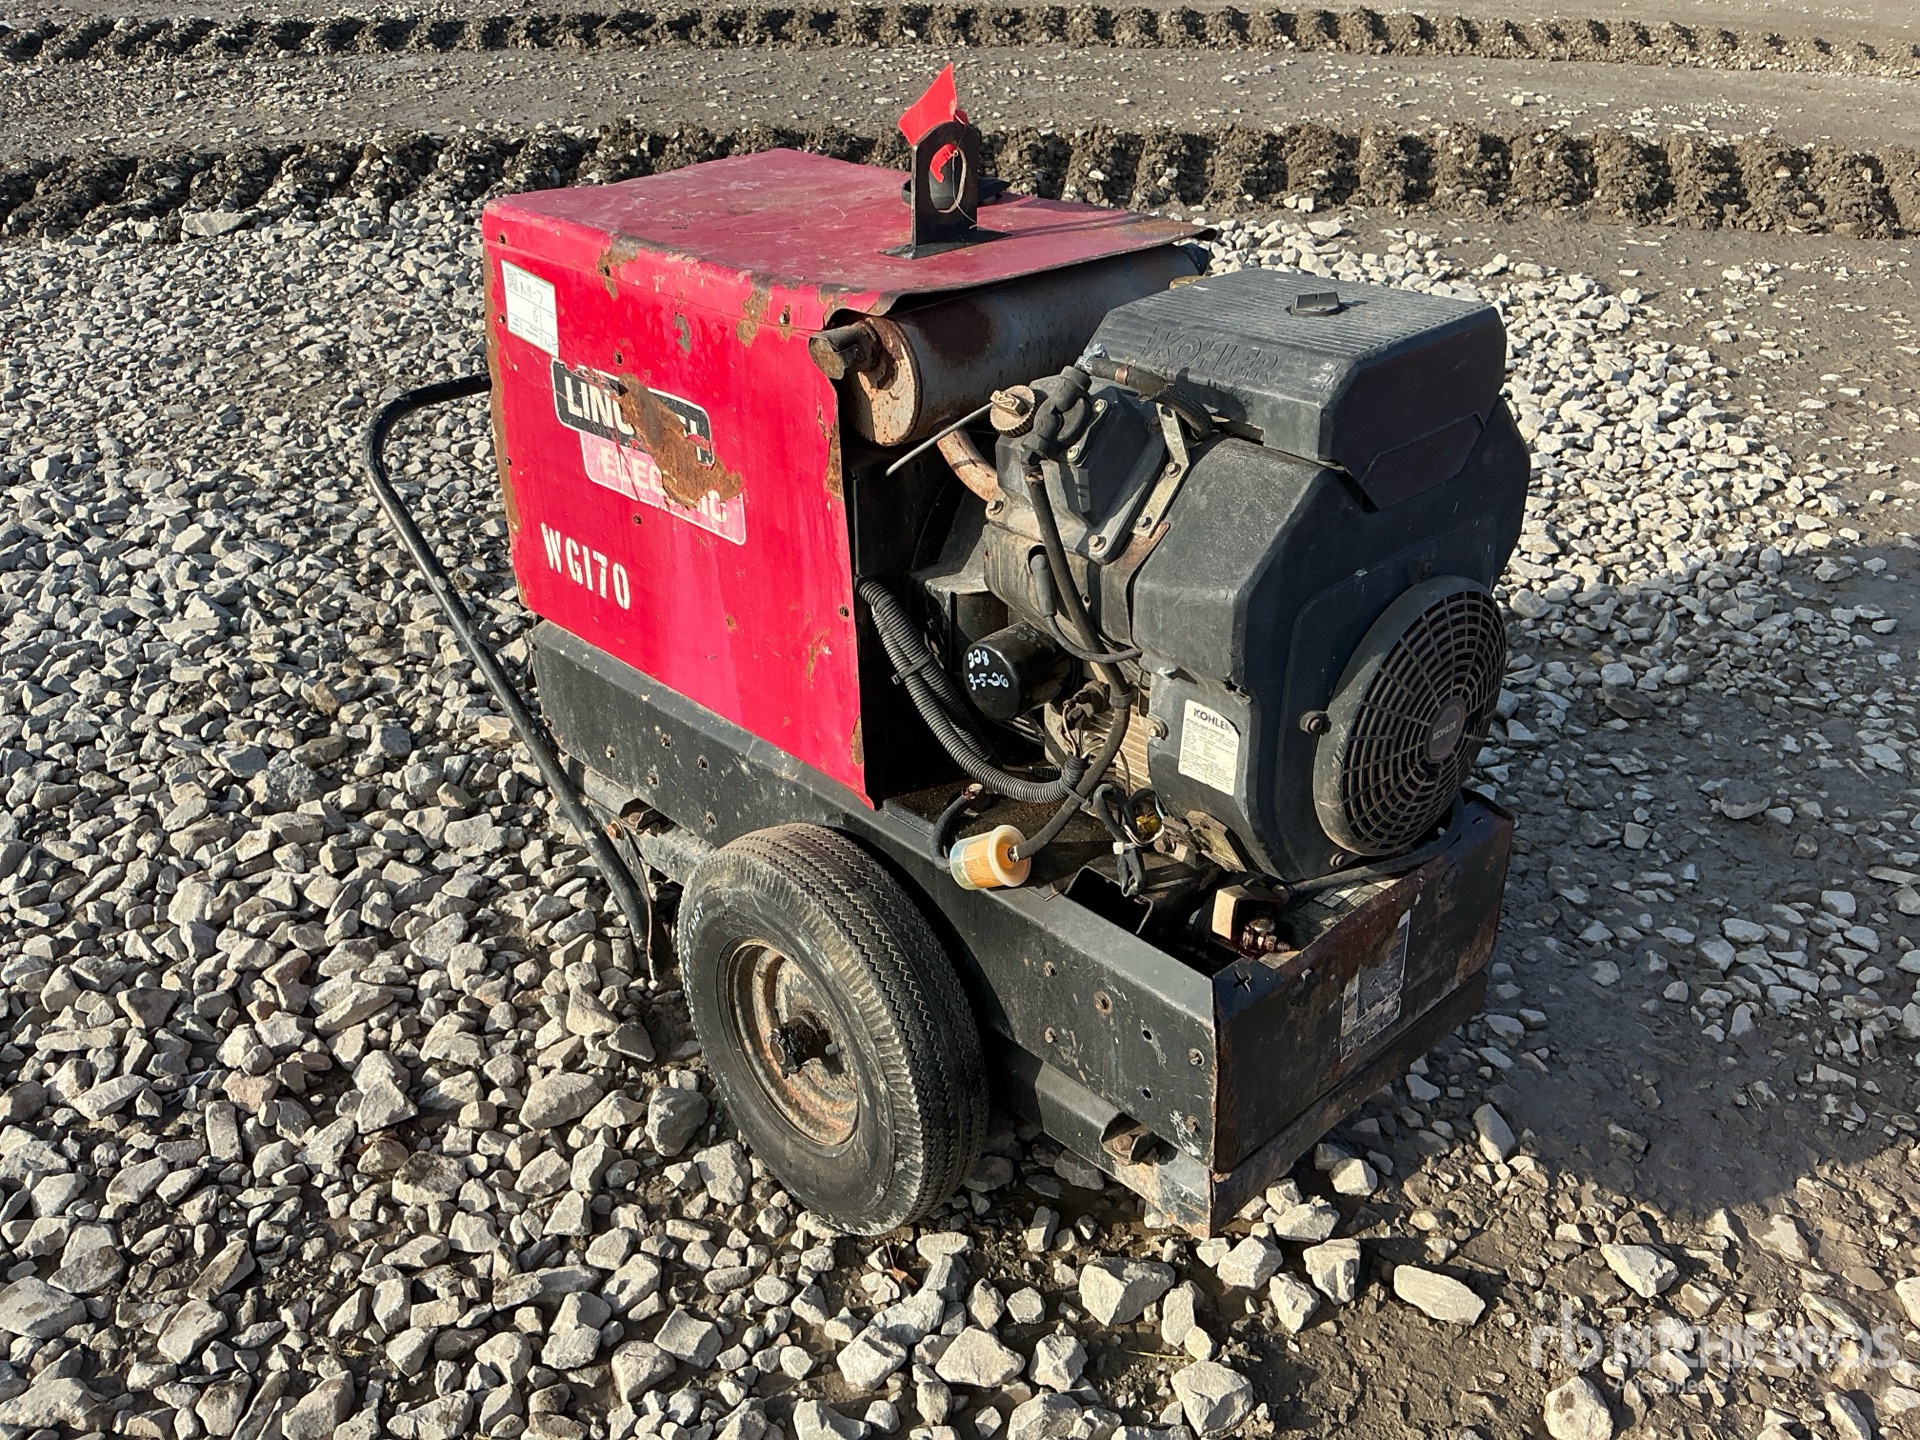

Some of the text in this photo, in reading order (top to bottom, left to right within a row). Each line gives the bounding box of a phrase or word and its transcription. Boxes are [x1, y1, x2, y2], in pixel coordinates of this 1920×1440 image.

[1141, 326, 1279, 384] KOHLER
[1193, 707, 1232, 735] KOHLER
[1432, 720, 1457, 741] KOHLER
